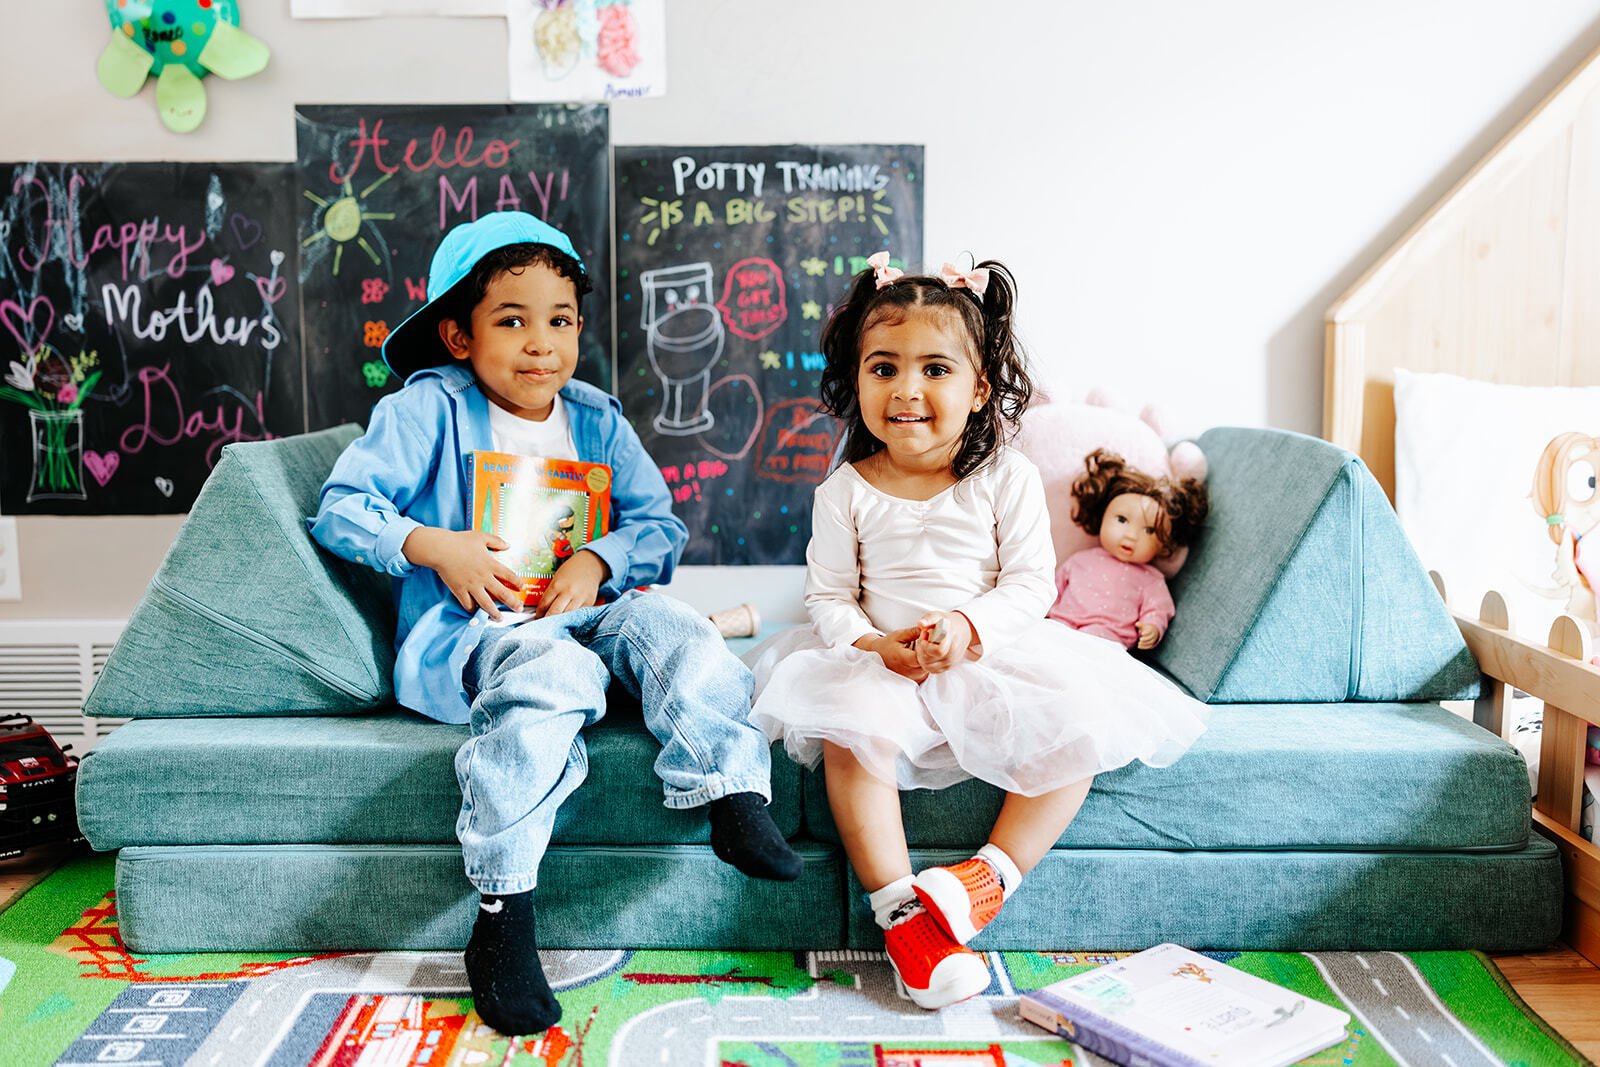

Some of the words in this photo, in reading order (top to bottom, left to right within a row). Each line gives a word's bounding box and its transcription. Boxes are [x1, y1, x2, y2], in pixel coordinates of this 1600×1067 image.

[329, 117, 520, 184] Hello
[672, 155, 766, 197] POTTY
[13, 169, 206, 280] Happy
[660, 200, 685, 230] IS
[693, 201, 714, 227] A
[725, 199, 777, 226] BIG
[786, 194, 867, 224] STEP!
[834, 255, 844, 276] I
[101, 282, 282, 350] Mothers
[785, 351, 795, 371] I
[483, 462, 519, 474] BEAR'
[547, 468, 586, 482] FAMILY
[22, 778, 55, 788] RAM
